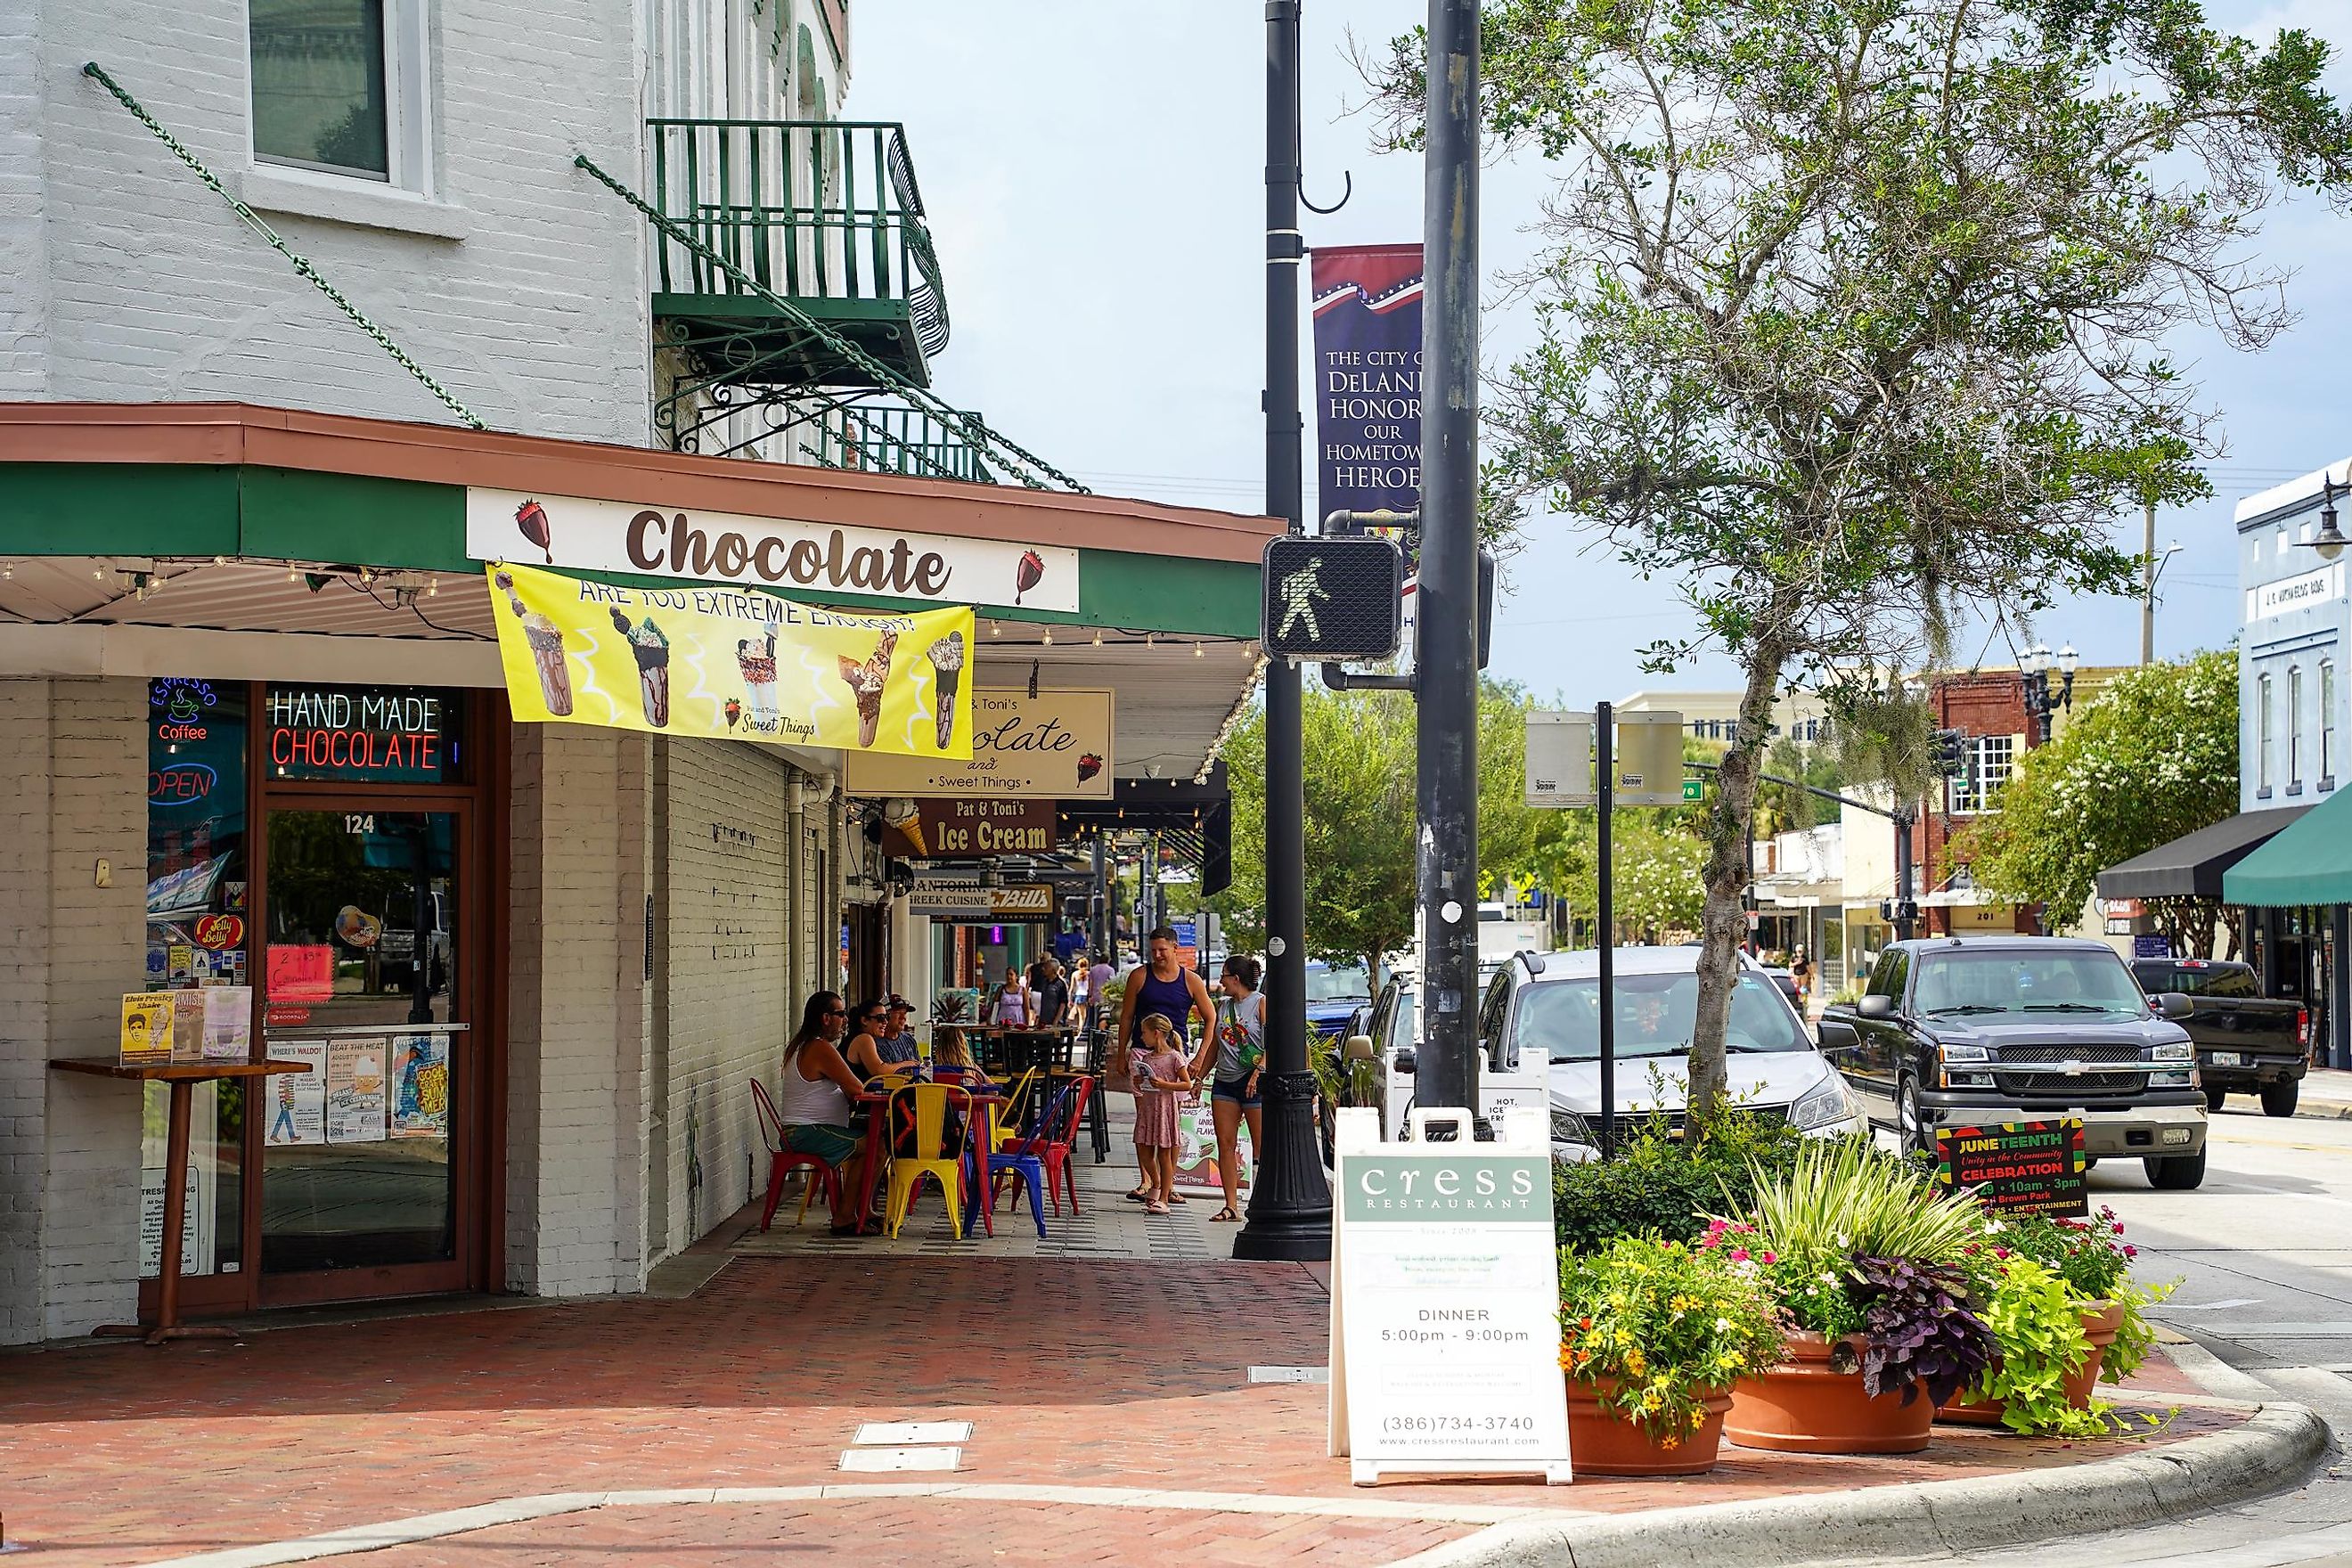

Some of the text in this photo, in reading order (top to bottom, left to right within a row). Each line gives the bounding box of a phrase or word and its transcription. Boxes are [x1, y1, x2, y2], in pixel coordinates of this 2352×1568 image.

[1326, 351, 1360, 366] THE
[1368, 351, 1408, 366] CITY
[1330, 398, 1423, 420] HONOR
[1363, 424, 1402, 439] OUR
[1326, 445, 1423, 461] HOMETOW
[1335, 466, 1421, 489] HEROE
[625, 510, 952, 595] Chocolate
[579, 579, 632, 605] ARE
[694, 592, 802, 625] EXTREME
[274, 690, 439, 732] HAND MADE
[982, 698, 1017, 710] Toni's
[159, 724, 208, 740] Coffee
[742, 713, 815, 744] Sweet Things
[972, 716, 1078, 753] olate
[272, 728, 440, 770] CHOCOLATE
[967, 757, 1001, 772] and
[148, 772, 212, 797] OPEN
[938, 775, 1021, 791] Sweet Things
[956, 800, 1025, 817] Pat & Toni's
[344, 814, 374, 834] 124
[937, 821, 1048, 852] Ice Cream
[911, 878, 987, 893] ANTORIN
[945, 894, 987, 906] CUISINE
[1000, 889, 1049, 908] Bill's
[1977, 912, 1994, 920] 201
[210, 918, 233, 933] Jelly
[201, 930, 227, 946] Belly
[125, 993, 174, 1003] Elvis Presley
[136, 1001, 161, 1009] Shake
[176, 992, 204, 1006] AMISU
[330, 1042, 385, 1051] BEAT THE HEAT
[418, 1065, 444, 1082] COOL
[420, 1076, 445, 1090] CRAFT
[421, 1086, 445, 1101] SUM
[423, 1097, 445, 1114] MER
[1497, 1098, 1518, 1109] HOT,
[1959, 1132, 2063, 1155] JUNETEENTH
[1961, 1149, 2063, 1167] Unity in the Community
[1960, 1162, 2063, 1182] CELEBRATION
[1360, 1167, 1533, 1196] cress
[1979, 1183, 1995, 1196] 29
[2008, 1180, 2043, 1192] 10am
[2054, 1178, 2081, 1191] 3pm
[1366, 1198, 1531, 1210] RESTAURANT
[1998, 1193, 2028, 1204] Brown
[2029, 1191, 2051, 1201] Park
[1418, 1310, 1490, 1321] DINNER
[1382, 1329, 1445, 1343] 5:00pm
[1465, 1329, 1530, 1343] 9:00pm
[1384, 1417, 1534, 1433] (386)734-3740
[1379, 1436, 1540, 1446] www.cressrestaurant.com
